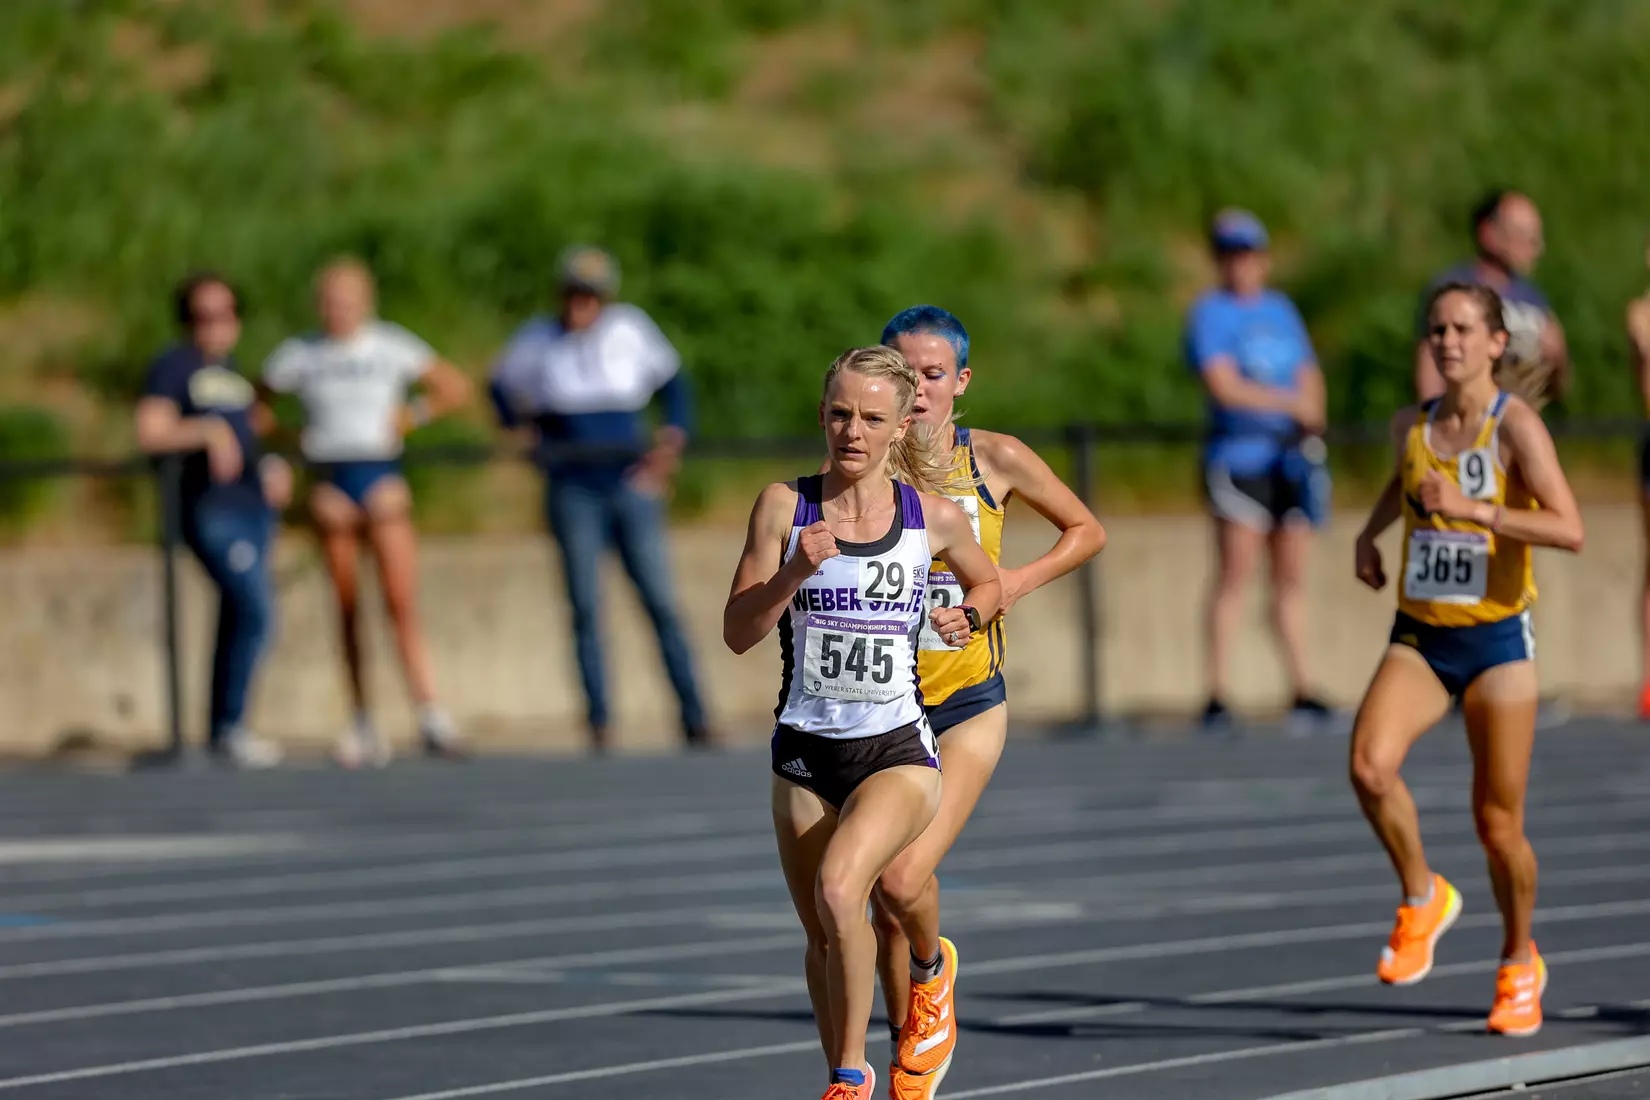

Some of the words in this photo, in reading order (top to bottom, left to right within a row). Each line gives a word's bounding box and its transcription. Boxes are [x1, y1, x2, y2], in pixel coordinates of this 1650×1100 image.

[1466, 453, 1485, 495] 9
[864, 560, 905, 600] 29
[1416, 544, 1472, 585] 365
[792, 587, 863, 612] WEBER
[839, 621, 887, 631] CHAMPIONSHIPS
[820, 633, 894, 684] 545
[824, 684, 845, 692] WEBER
[781, 763, 812, 778] adidas
